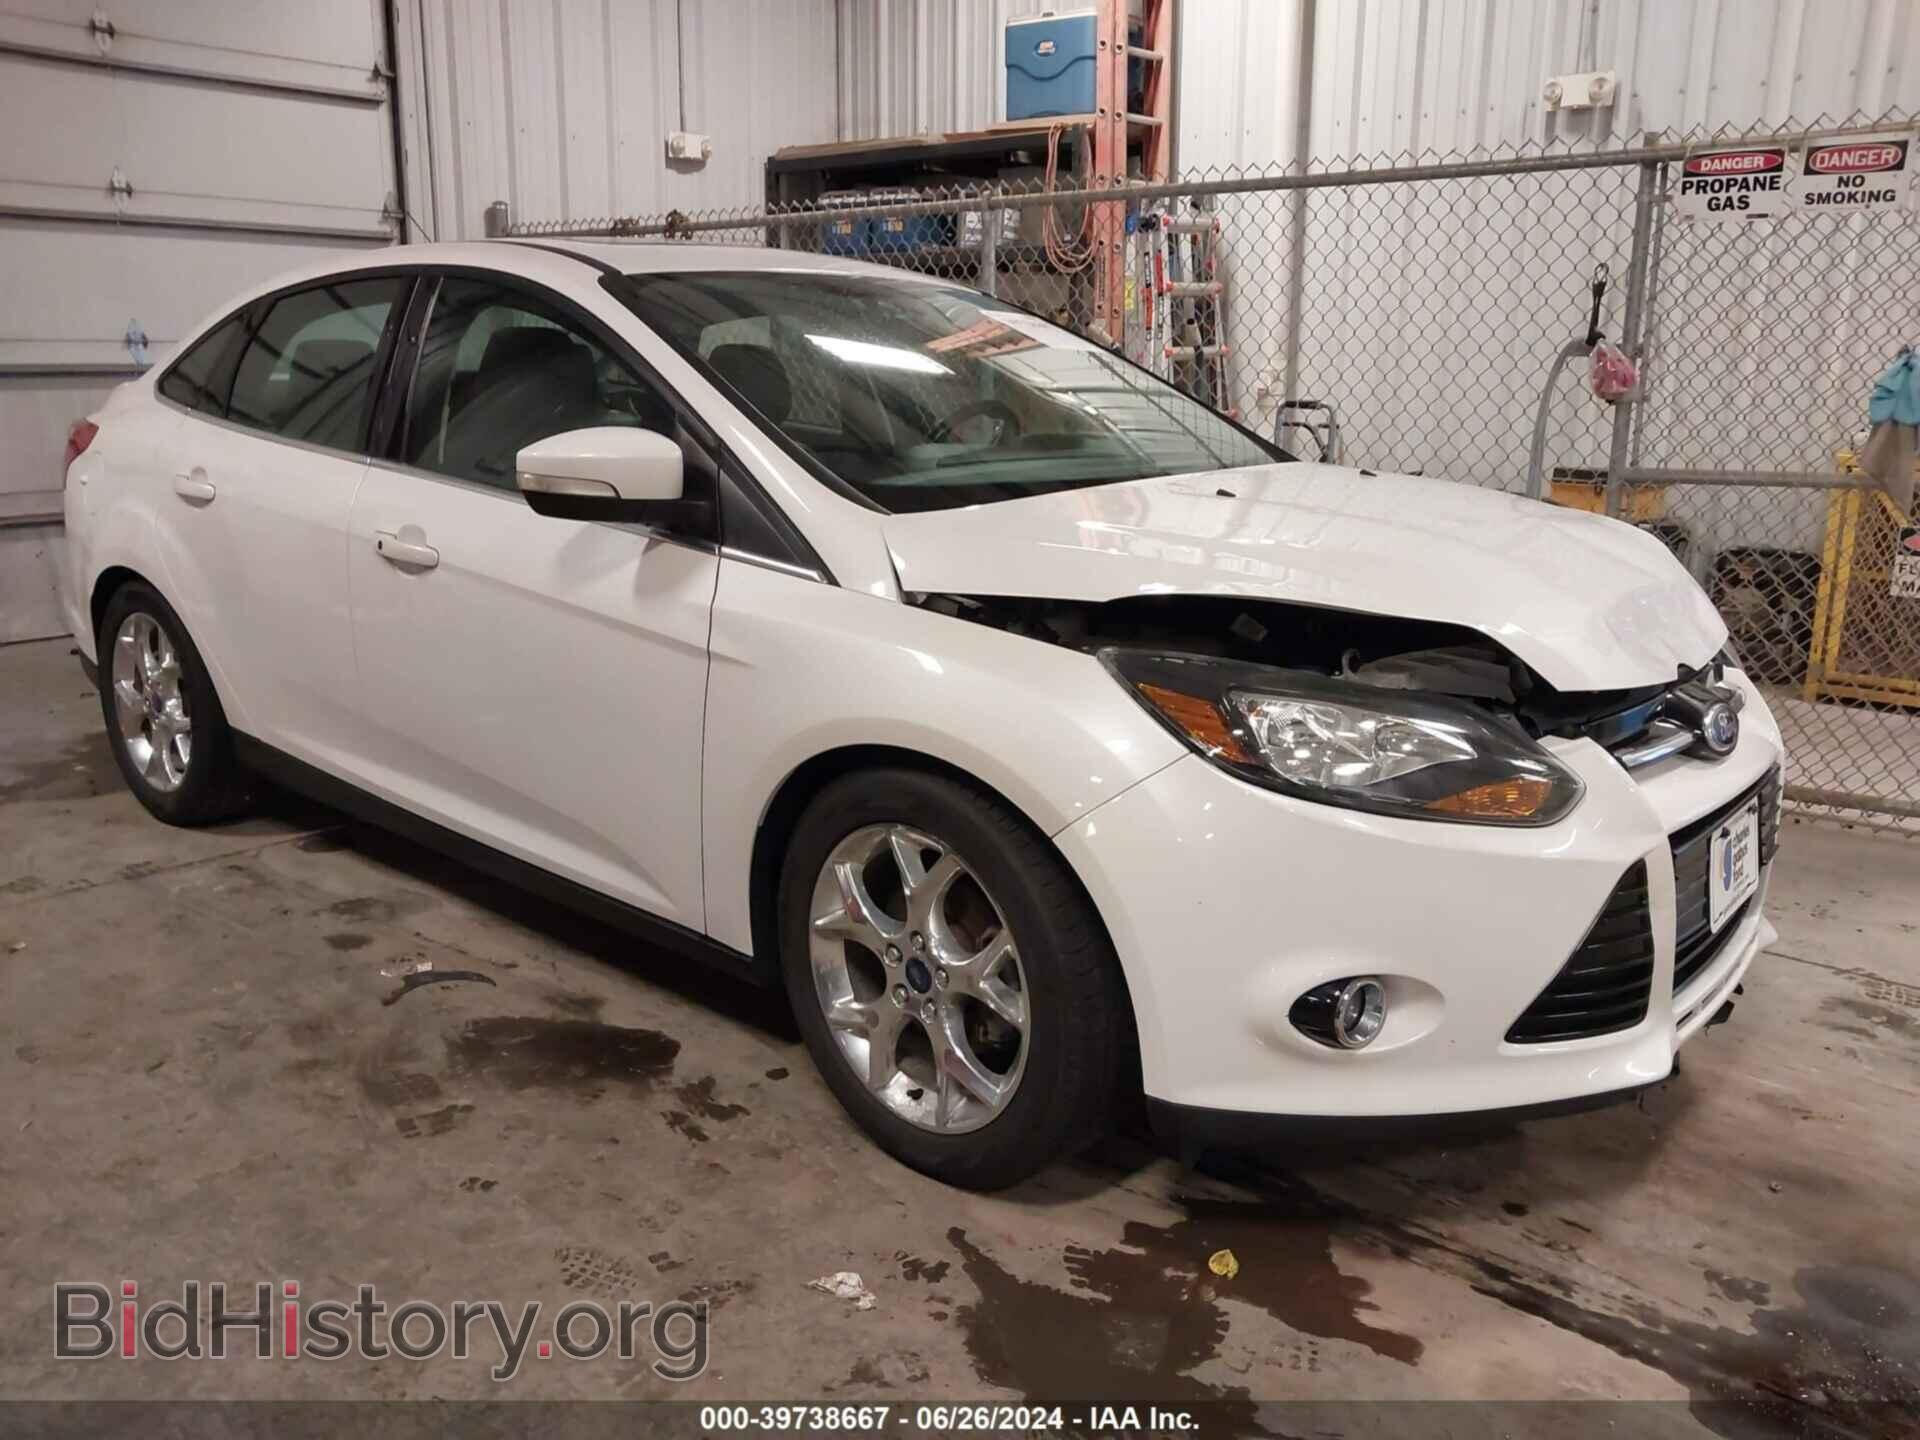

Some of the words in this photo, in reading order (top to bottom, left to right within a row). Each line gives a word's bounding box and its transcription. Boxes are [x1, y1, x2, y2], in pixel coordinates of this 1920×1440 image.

[1700, 156, 1765, 172] DANGER
[1815, 149, 1896, 168] DANGER
[1681, 175, 1782, 195] PROPANE
[1837, 175, 1866, 189] NO
[1707, 195, 1750, 212] GAS
[1804, 189, 1896, 206] SMOKING
